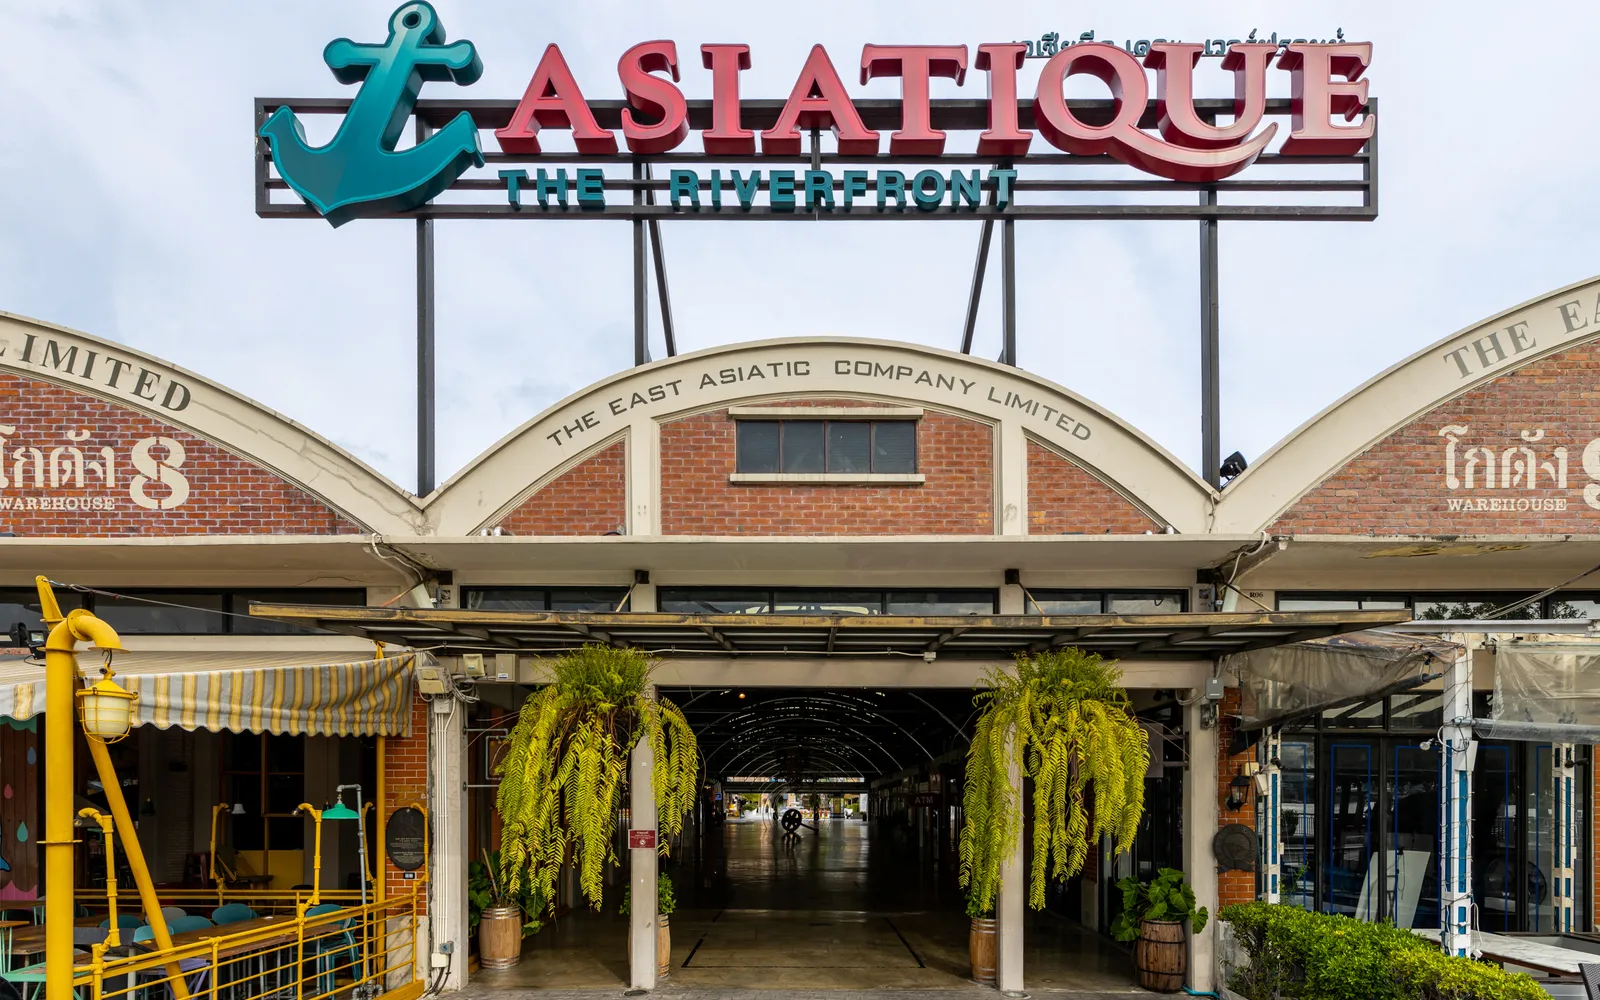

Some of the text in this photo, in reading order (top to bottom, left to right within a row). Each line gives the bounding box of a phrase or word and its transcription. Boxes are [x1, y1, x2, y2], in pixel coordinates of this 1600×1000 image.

[494, 39, 1375, 182] ASIATIQUE
[498, 168, 1017, 211] THE RIVERFRONT
[0, 333, 191, 411] IMITED
[1443, 292, 1600, 379] THE E
[546, 360, 1092, 446] THE EAST ASIATIC COMPANY LIMITED
[129, 436, 190, 510] 8
[1438, 424, 1568, 490] โกดัง
[1447, 498, 1567, 511] WAREHOUSE
[914, 796, 934, 804] ATM
